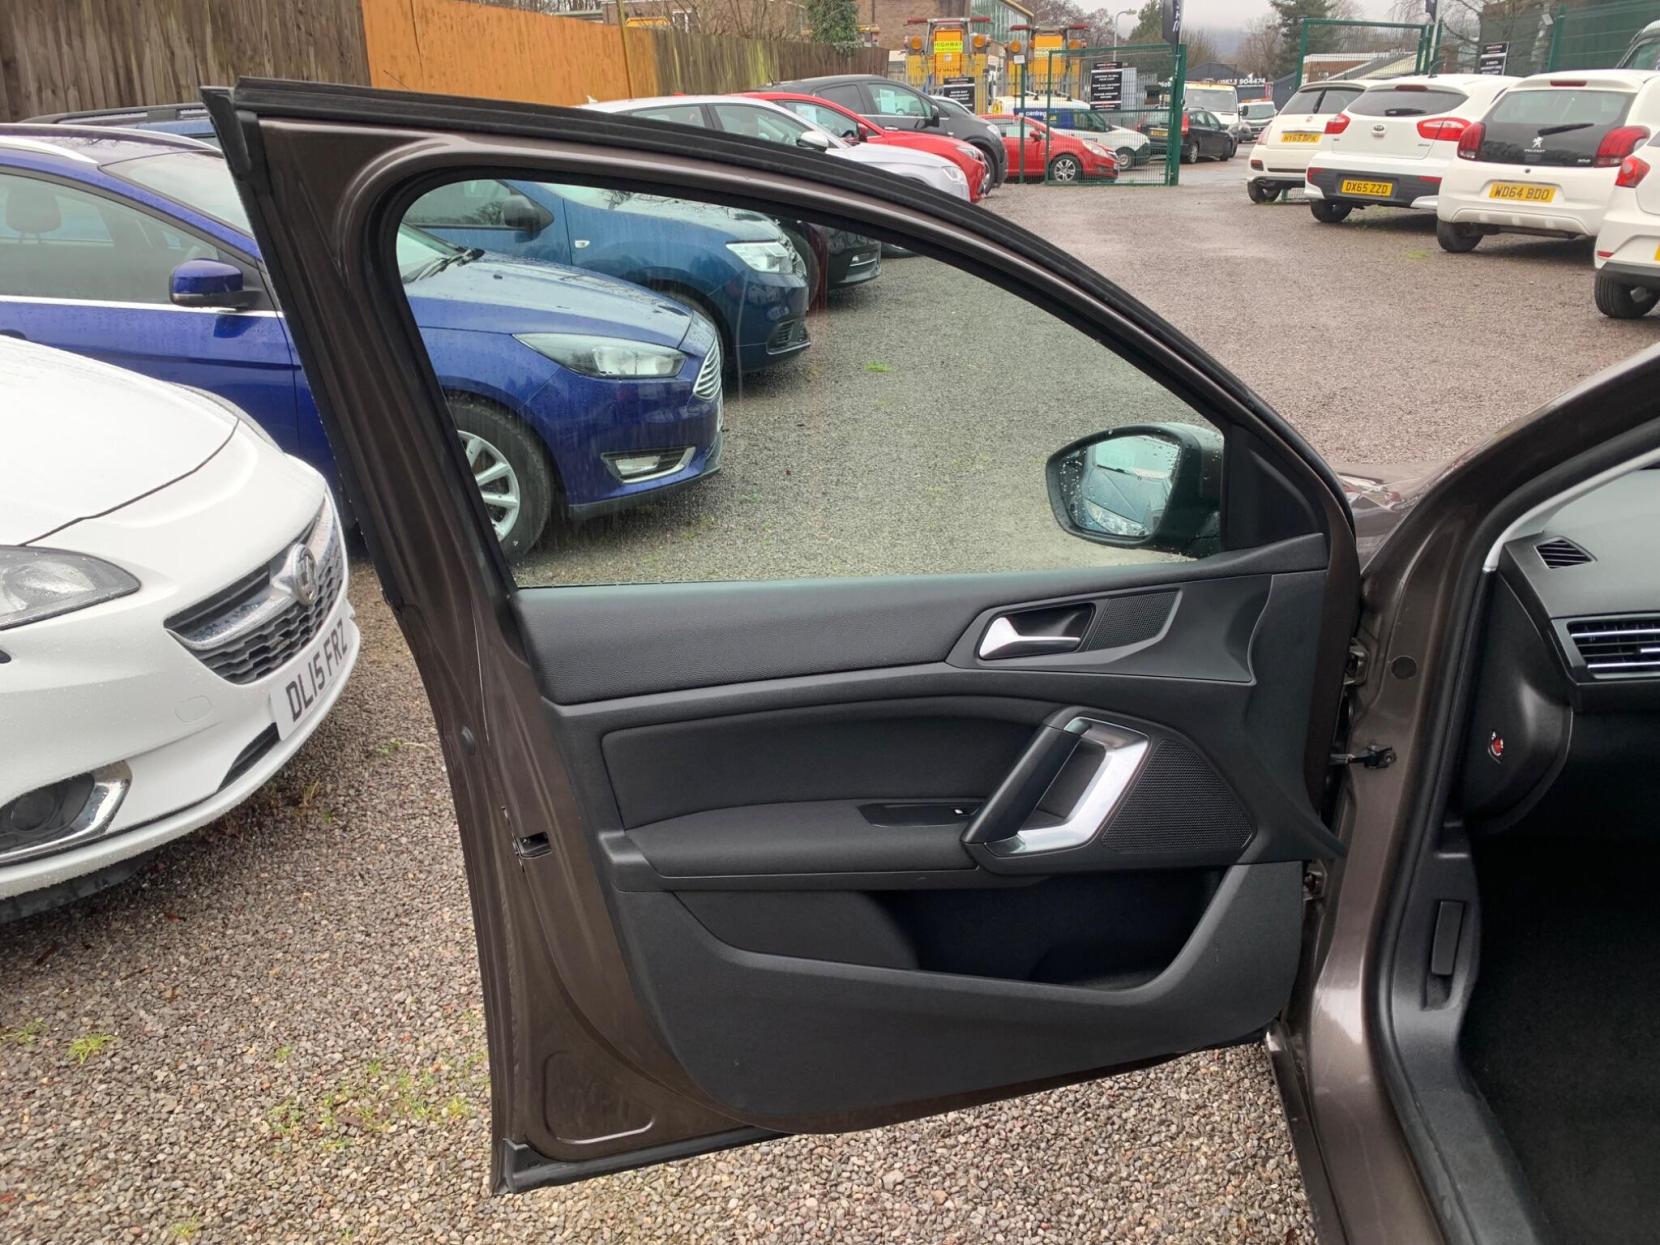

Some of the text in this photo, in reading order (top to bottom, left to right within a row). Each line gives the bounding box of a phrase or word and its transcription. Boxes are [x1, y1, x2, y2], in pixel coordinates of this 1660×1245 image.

[1345, 181, 1368, 193] DX65
[1494, 185, 1523, 198] WD64
[285, 618, 349, 723] DL15 FRZ
